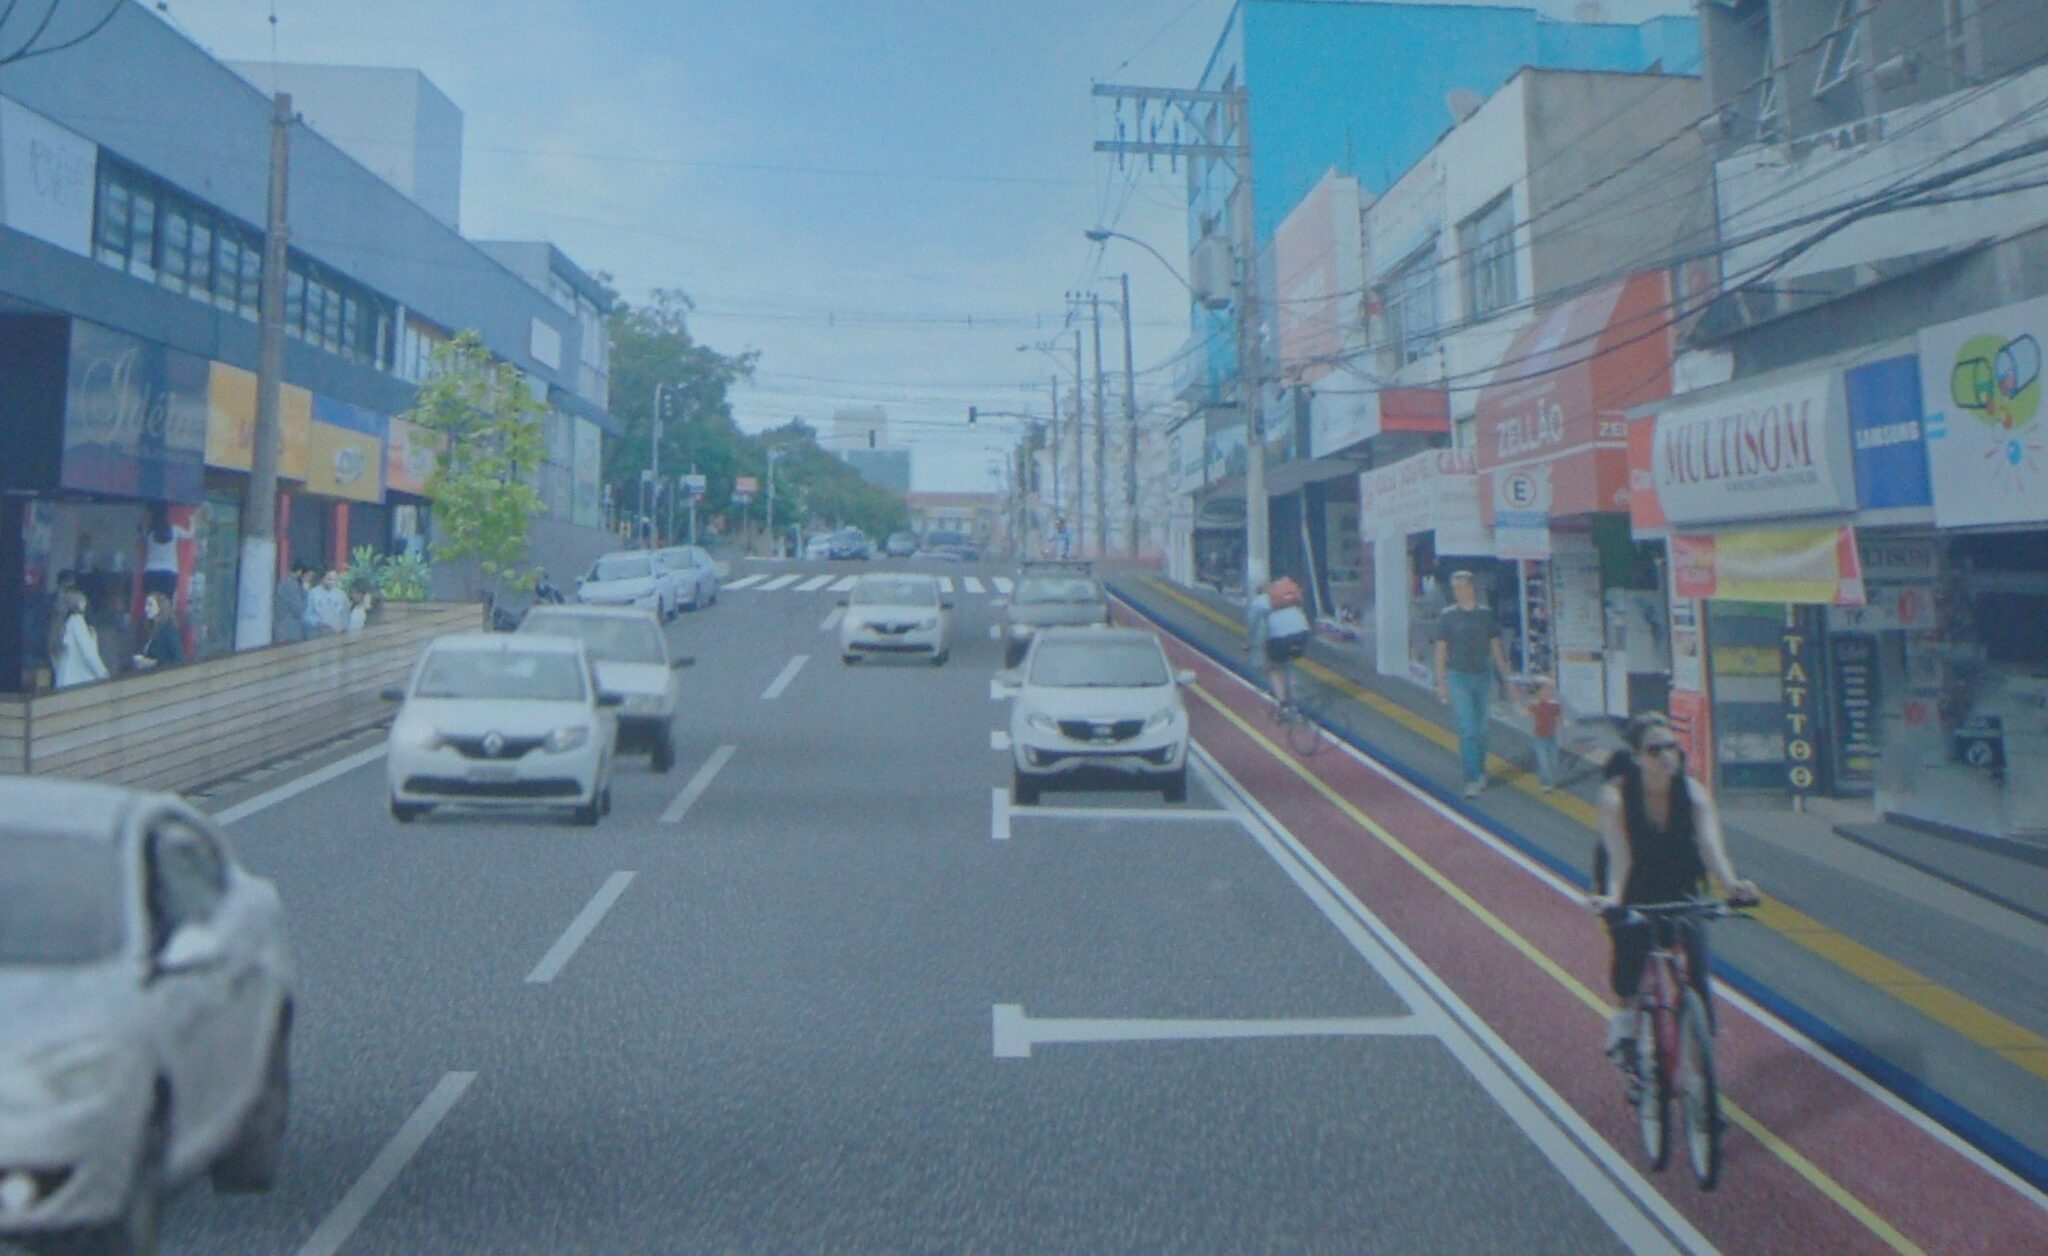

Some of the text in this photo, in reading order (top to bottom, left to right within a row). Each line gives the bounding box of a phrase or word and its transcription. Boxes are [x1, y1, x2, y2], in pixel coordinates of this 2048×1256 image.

[1498, 400, 1563, 457] ZELLÃO
[1666, 401, 1814, 484] MULTISOM
[1857, 422, 1920, 448] SAMSUNG
[1512, 480, 1527, 502] E
[1785, 636, 1813, 786] TATTOO
